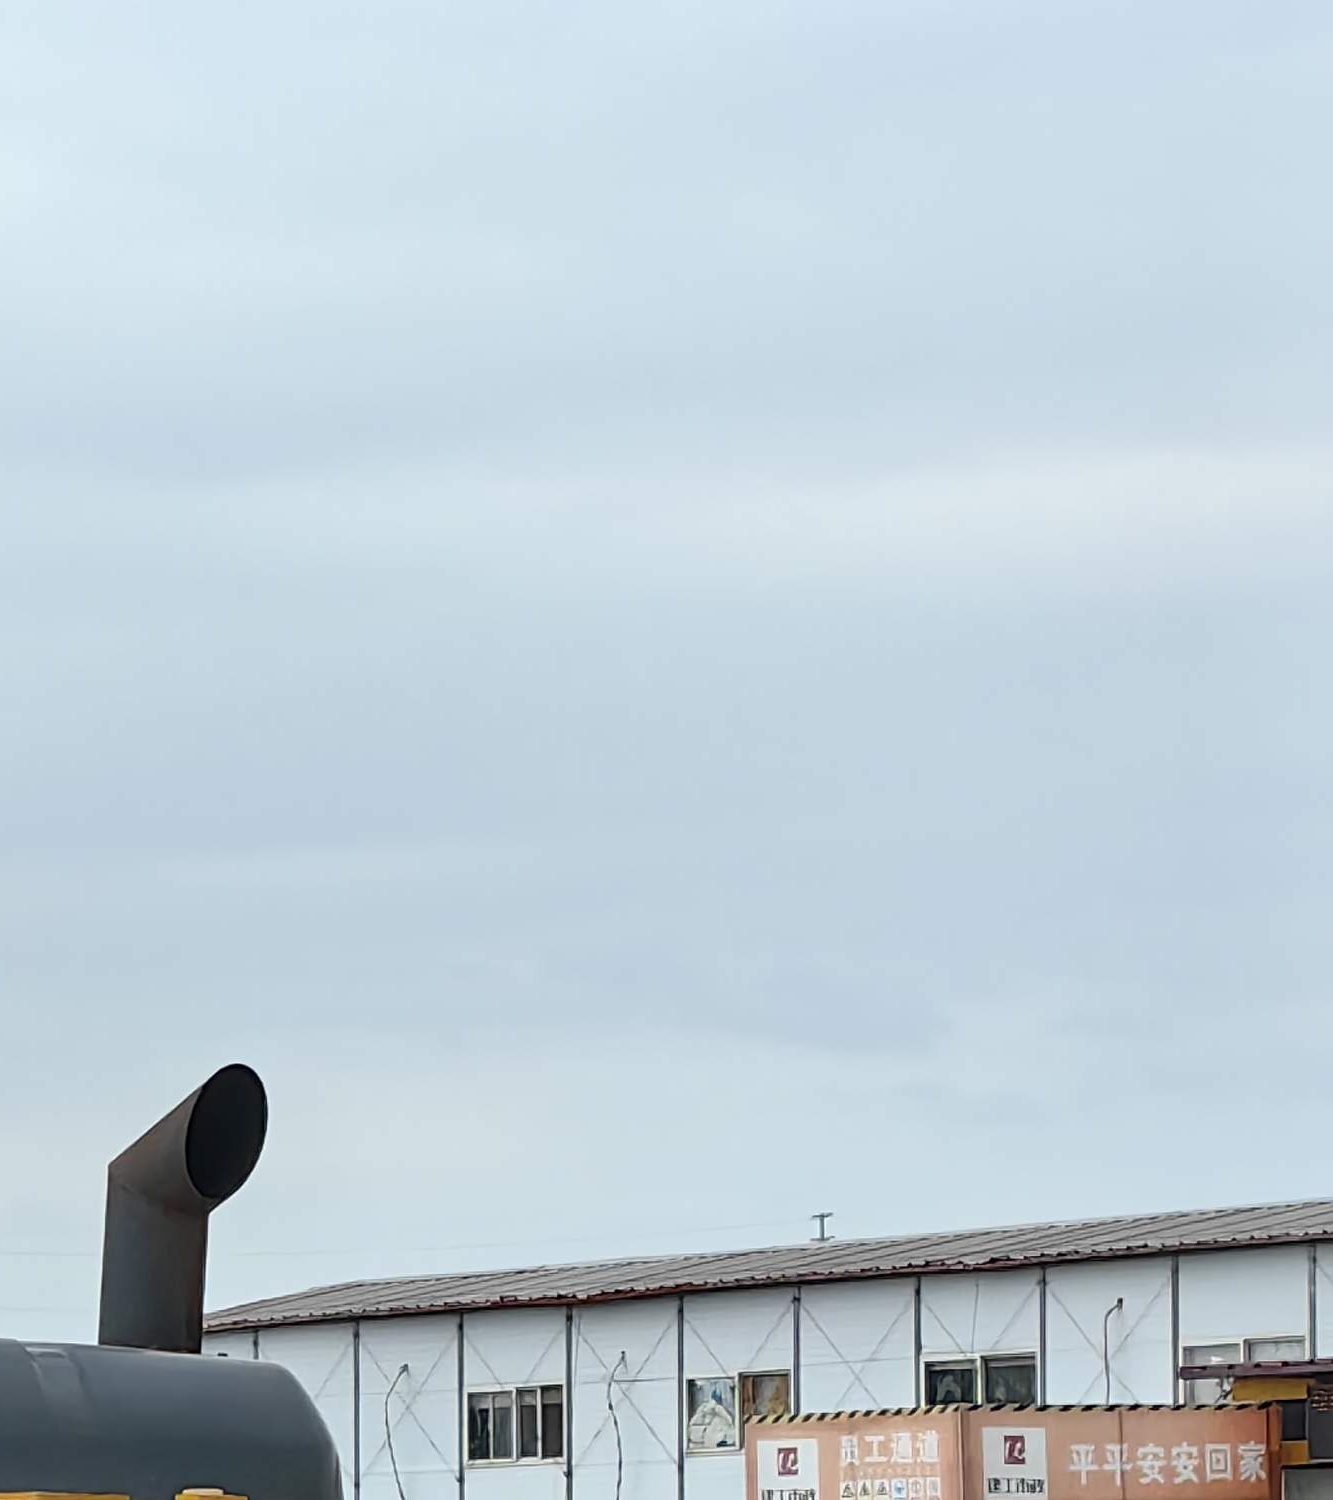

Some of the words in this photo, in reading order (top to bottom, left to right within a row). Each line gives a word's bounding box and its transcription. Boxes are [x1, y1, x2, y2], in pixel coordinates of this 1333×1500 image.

[1069, 1441, 1267, 1487] 平平安安回家
